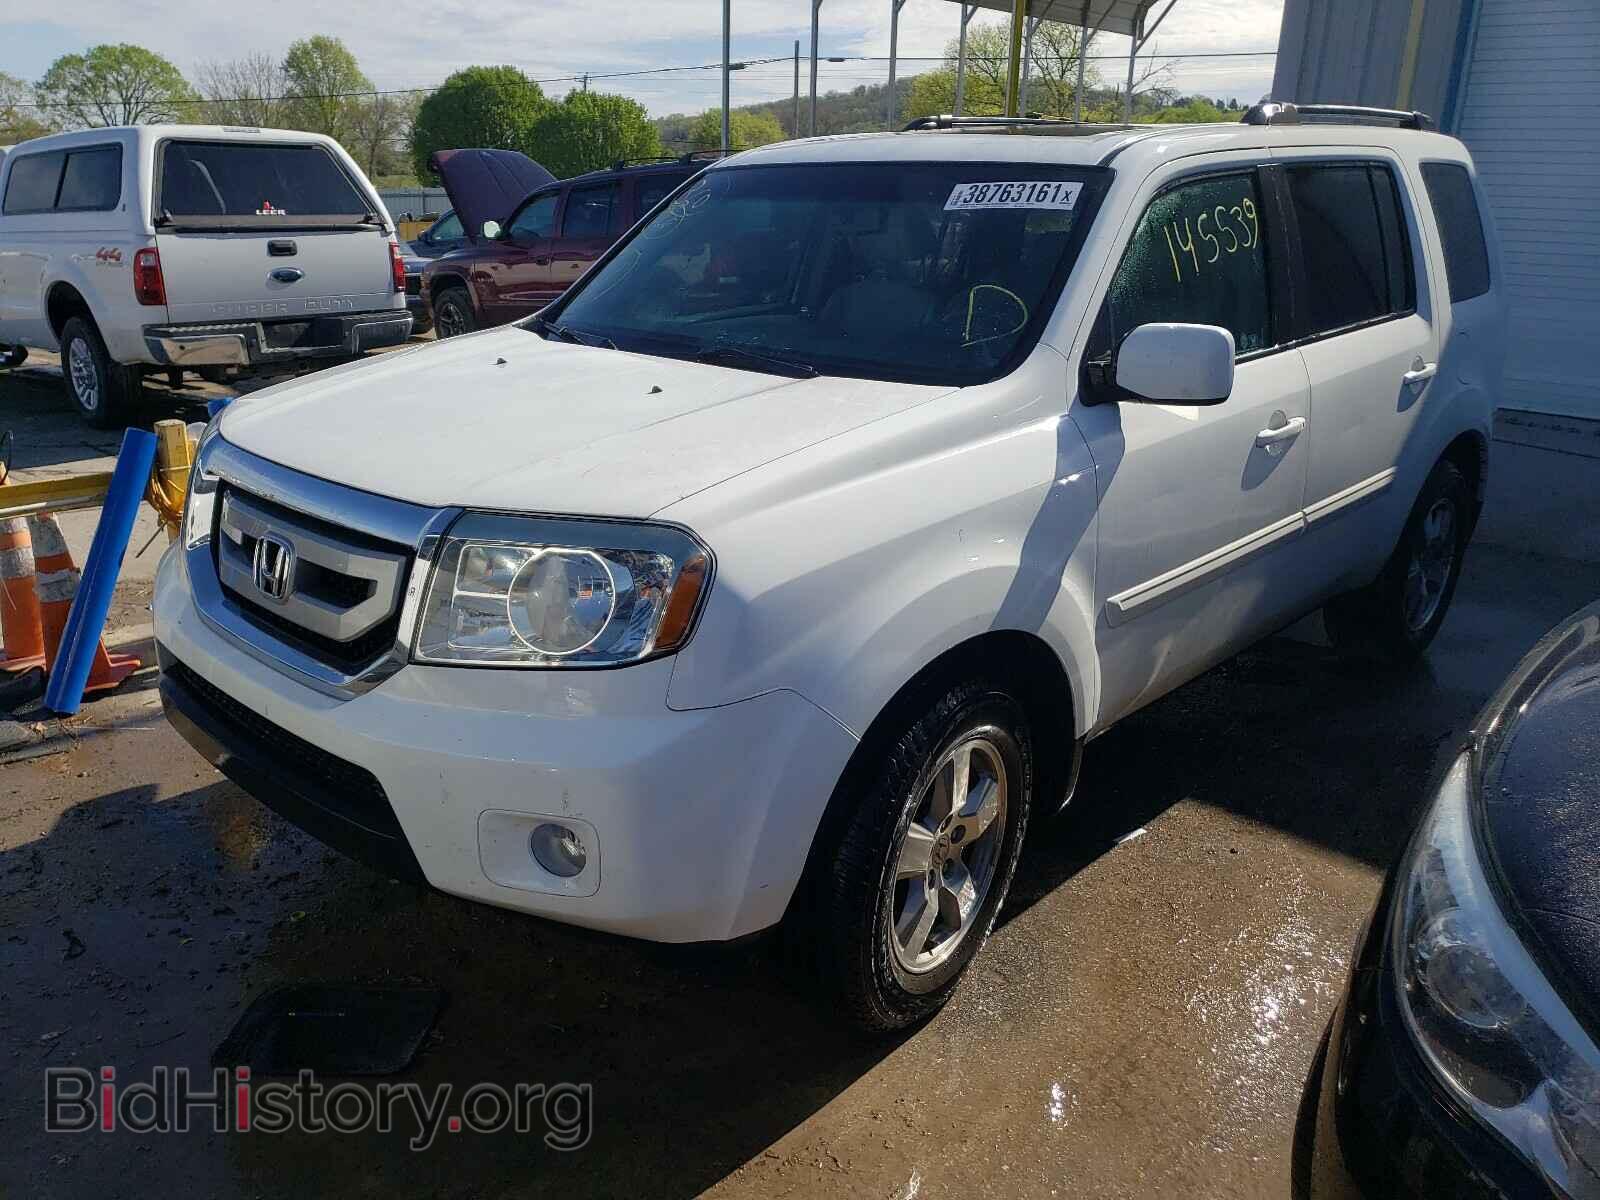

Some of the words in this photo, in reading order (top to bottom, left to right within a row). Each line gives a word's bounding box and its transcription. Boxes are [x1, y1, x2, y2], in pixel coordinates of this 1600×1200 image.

[963, 183, 1063, 203] 38763161
[1163, 198, 1259, 282] 145539
[960, 284, 1029, 348] D
